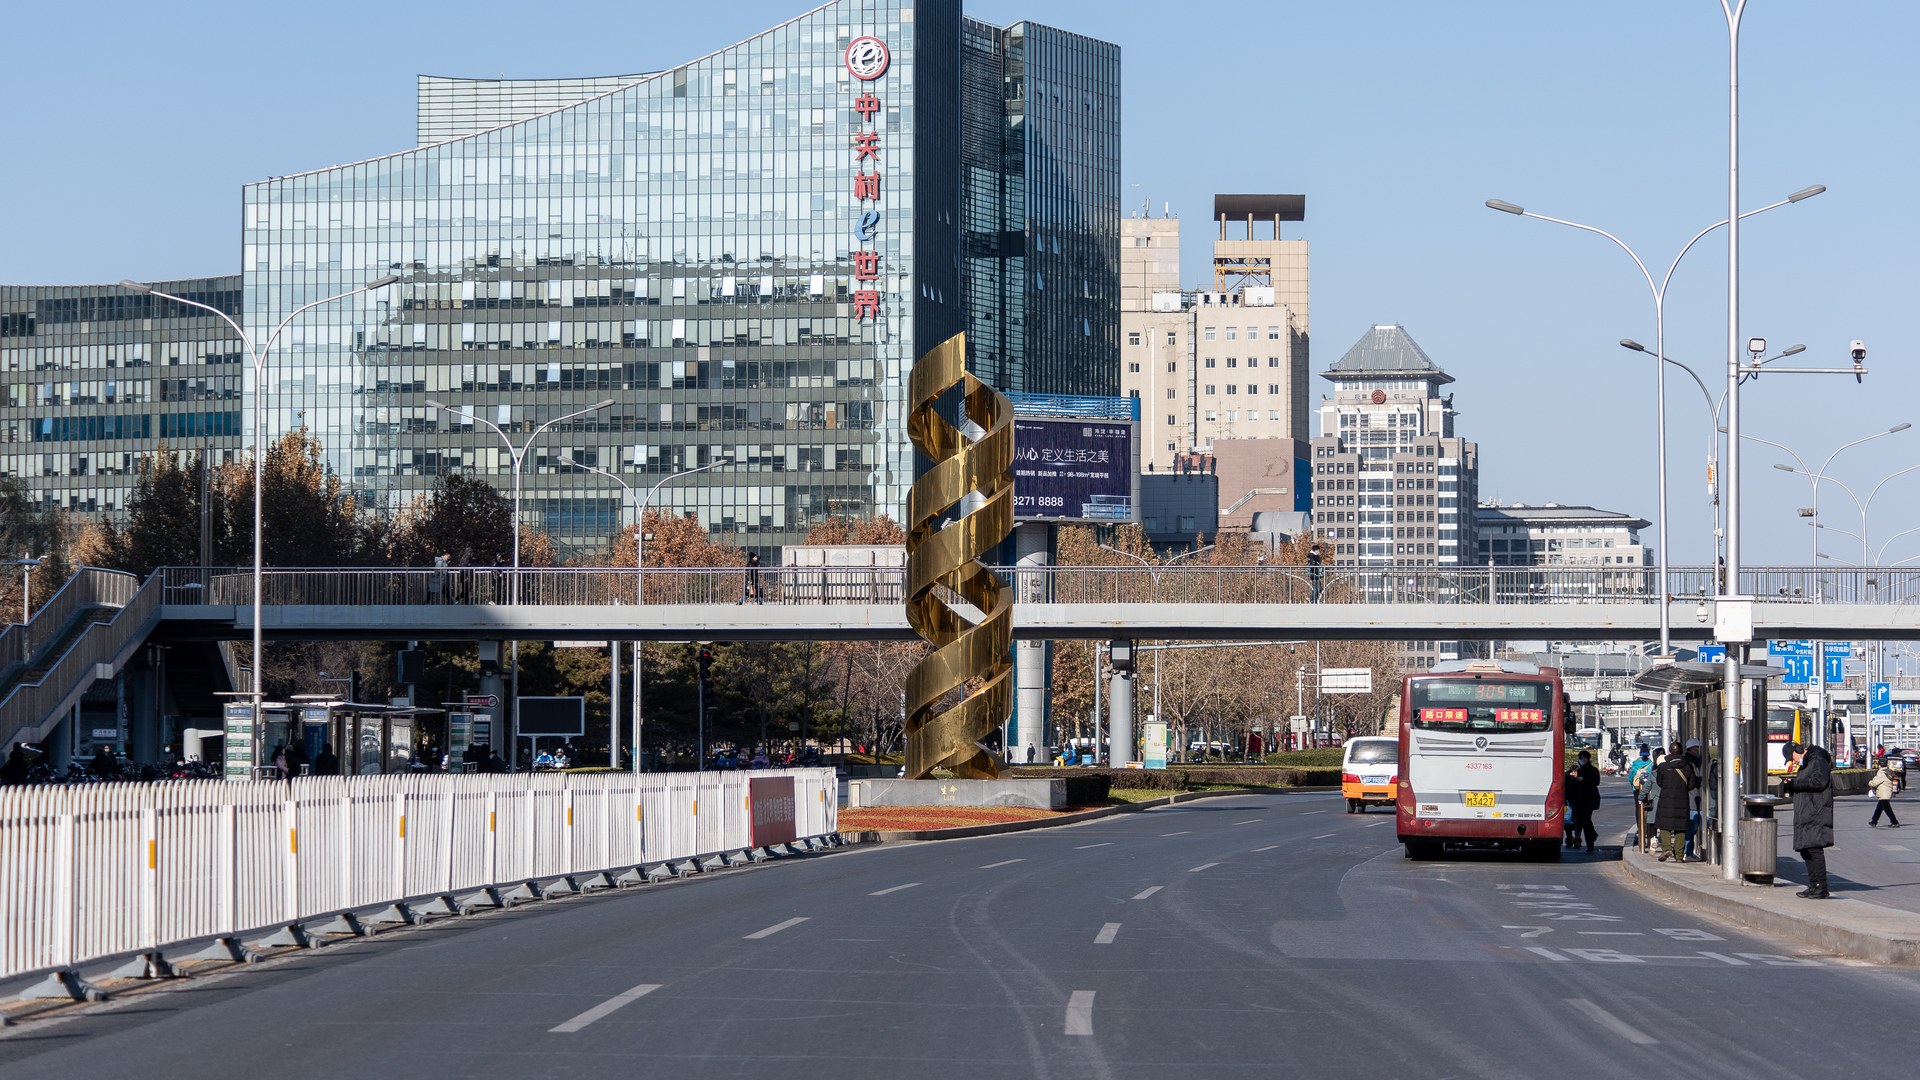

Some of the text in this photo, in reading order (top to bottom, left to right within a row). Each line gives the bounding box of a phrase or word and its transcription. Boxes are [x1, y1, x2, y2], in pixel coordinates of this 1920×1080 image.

[855, 92, 879, 319] 中关村e世界
[1016, 447, 1109, 463] 从心 定义生活之美
[1038, 497, 1064, 507] 8888
[1476, 685, 1505, 699] 305
[1425, 711, 1464, 719] 路口限速
[1500, 711, 1539, 721] 谨慎驾驶
[940, 785, 957, 794] 生命
[1467, 797, 1494, 806] M3427
